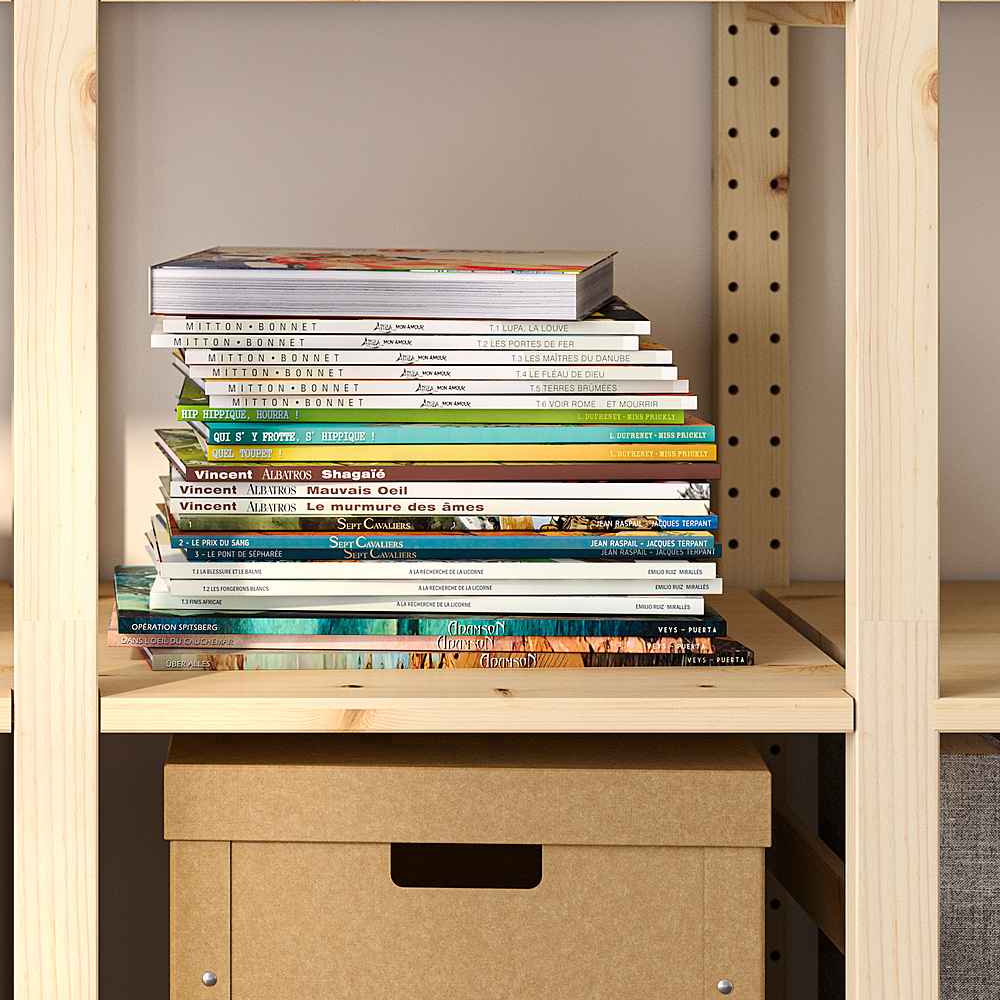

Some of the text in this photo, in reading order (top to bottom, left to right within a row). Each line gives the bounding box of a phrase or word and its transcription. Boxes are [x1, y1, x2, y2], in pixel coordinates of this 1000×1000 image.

[186, 322, 317, 331] MITTON BONNET
[502, 325, 526, 333] LUPA,
[173, 338, 305, 346] MITTON BONNET
[477, 340, 575, 348] T.2 LES PORTES DE FER
[208, 353, 340, 362] MITTON BONNET
[542, 353, 579, 362] MAÎTRES
[212, 368, 344, 377] MITTON BONNET
[516, 368, 605, 378] T.4 LE FLÉAU DE DIEU
[228, 384, 359, 393] MITTON BONNET
[543, 384, 575, 392] TERRES
[232, 398, 364, 407] MITTON BONNET
[536, 400, 659, 408] T.6 VOIR ROME... ET MOURRIR
[181, 409, 290, 420] HIP HIPPIQUE, HOURRA
[645, 413, 676, 421] PRICKLY
[213, 432, 231, 443] QUI
[251, 432, 258, 442] Y
[262, 432, 300, 443] FROTTE,
[321, 431, 366, 442] HIPPIQUE
[211, 448, 273, 459] QUEL TOUPET
[659, 450, 676, 458] MISS
[677, 450, 708, 458] PRICKLY
[194, 470, 253, 480] Vincent
[321, 468, 386, 481] Shagaïé
[179, 485, 237, 495] Vincent
[306, 485, 372, 495] Mauvais
[377, 486, 408, 495] Oeil
[179, 501, 237, 511] Vincent
[306, 502, 325, 511] Le
[331, 502, 402, 512] murmure
[407, 502, 436, 511] des
[441, 502, 485, 511] âmes
[651, 520, 680, 528] JACQUES
[191, 539, 200, 547] LE
[202, 539, 218, 547] PRIX
[220, 539, 230, 547] DU
[231, 539, 250, 547] SANG
[646, 540, 675, 548] JACQUES
[194, 549, 282, 558] 3 LE PONT DE SÉPHARÉE
[655, 549, 685, 557] JACQUES
[131, 622, 177, 631] OPÉRATION
[121, 637, 234, 645] DANS L'OEIL DU CAUCHEMAR
[187, 660, 211, 668] ALLES
